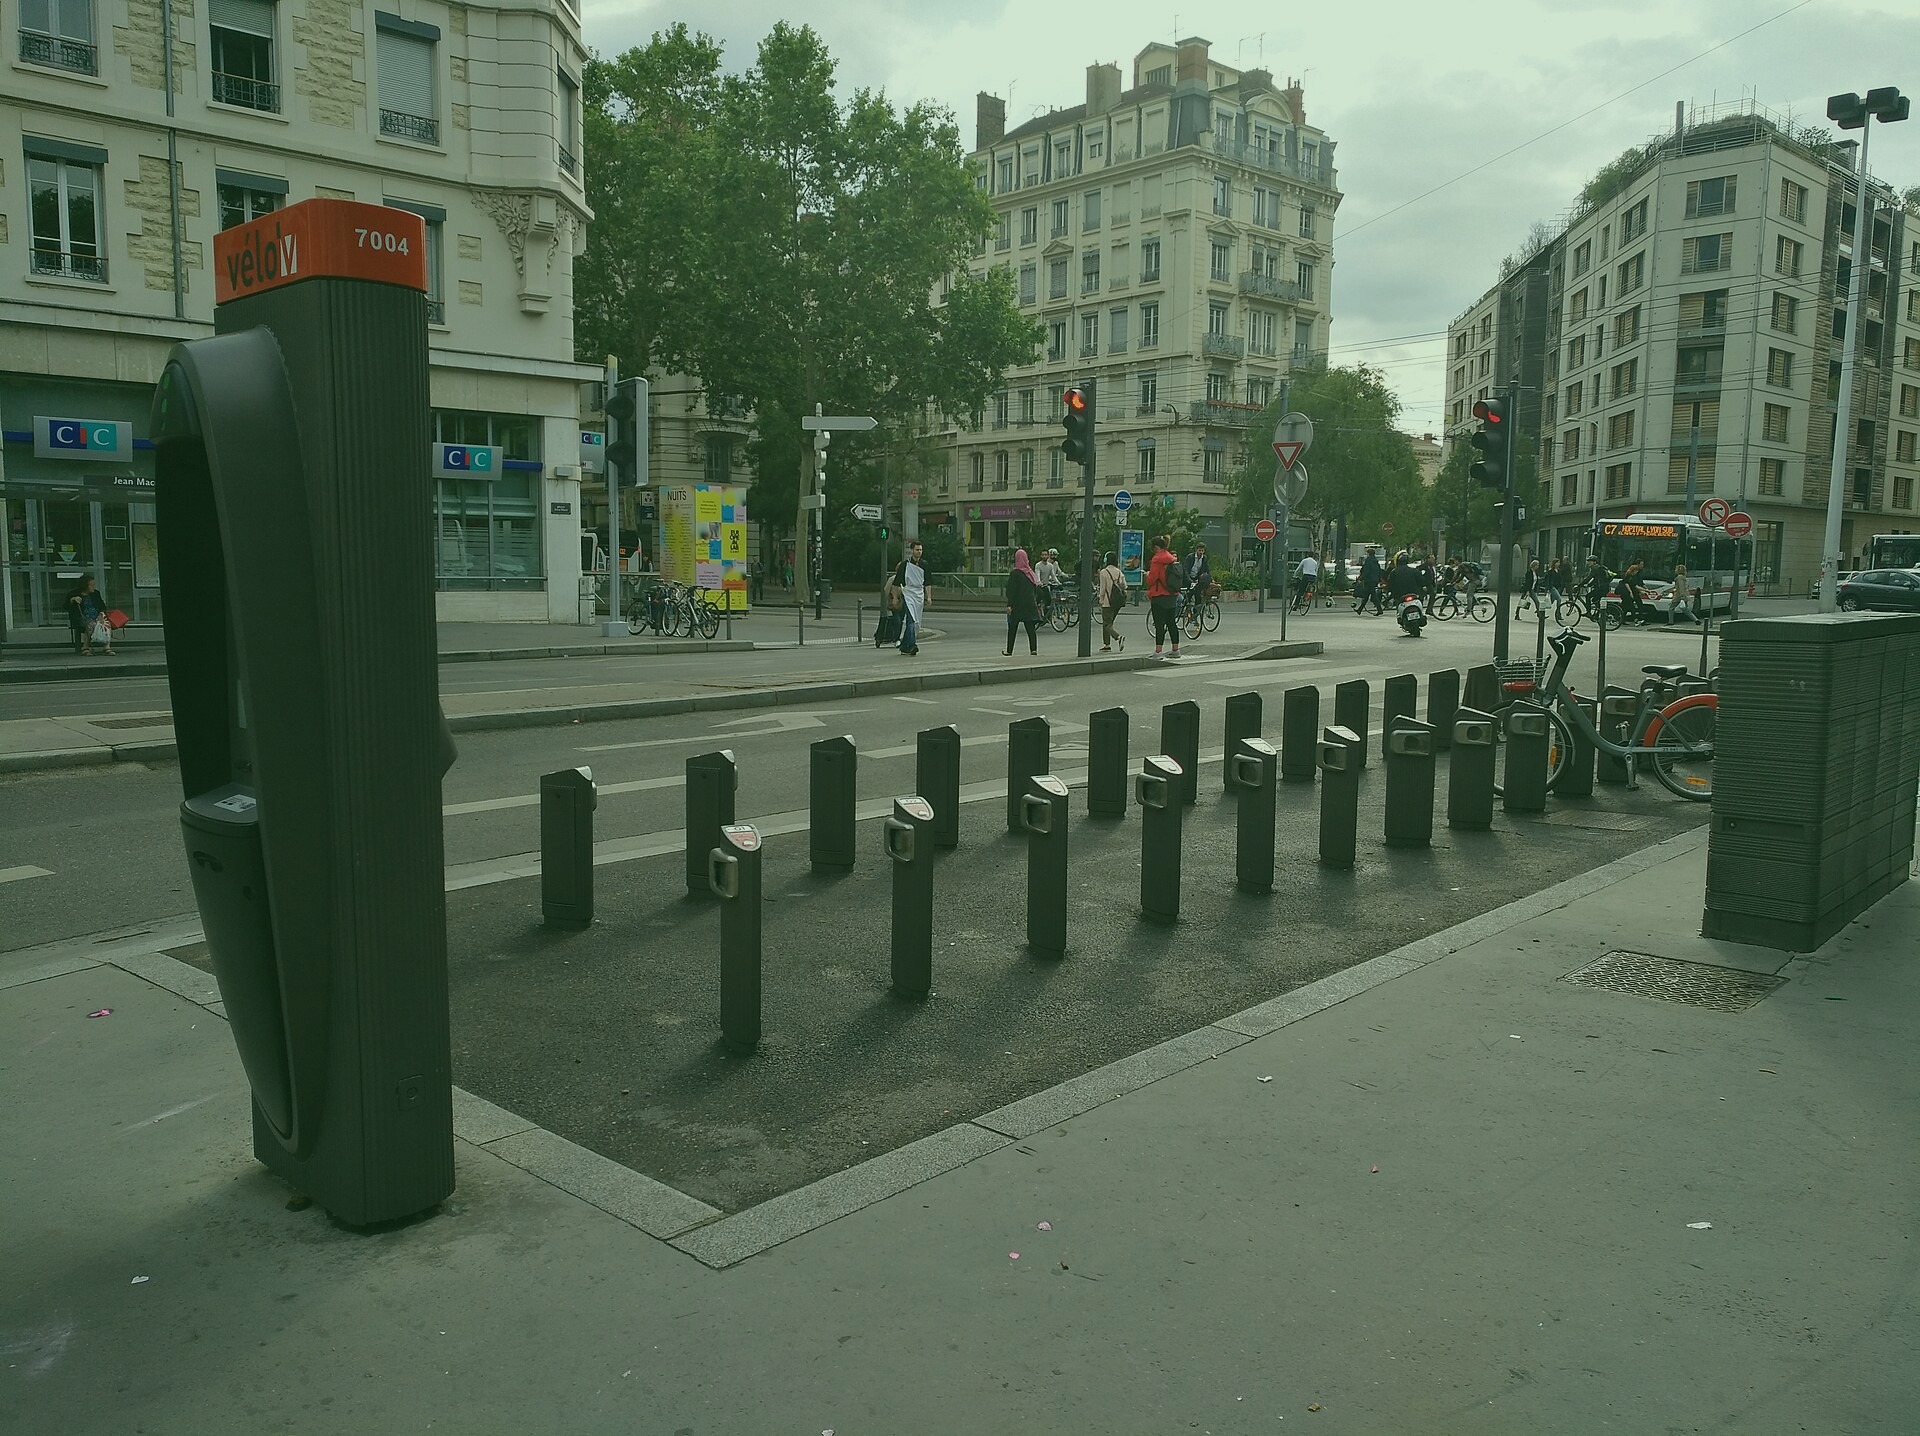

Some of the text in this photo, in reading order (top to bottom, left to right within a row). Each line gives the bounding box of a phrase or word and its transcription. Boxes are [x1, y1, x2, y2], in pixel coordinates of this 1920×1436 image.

[354, 228, 409, 256] 7004
[56, 426, 110, 446] CIC
[583, 434, 600, 444] CIC
[448, 450, 487, 467] CIC
[113, 476, 155, 486] Jean Mac
[667, 490, 687, 501] NUITS
[1604, 524, 1618, 535] C7
